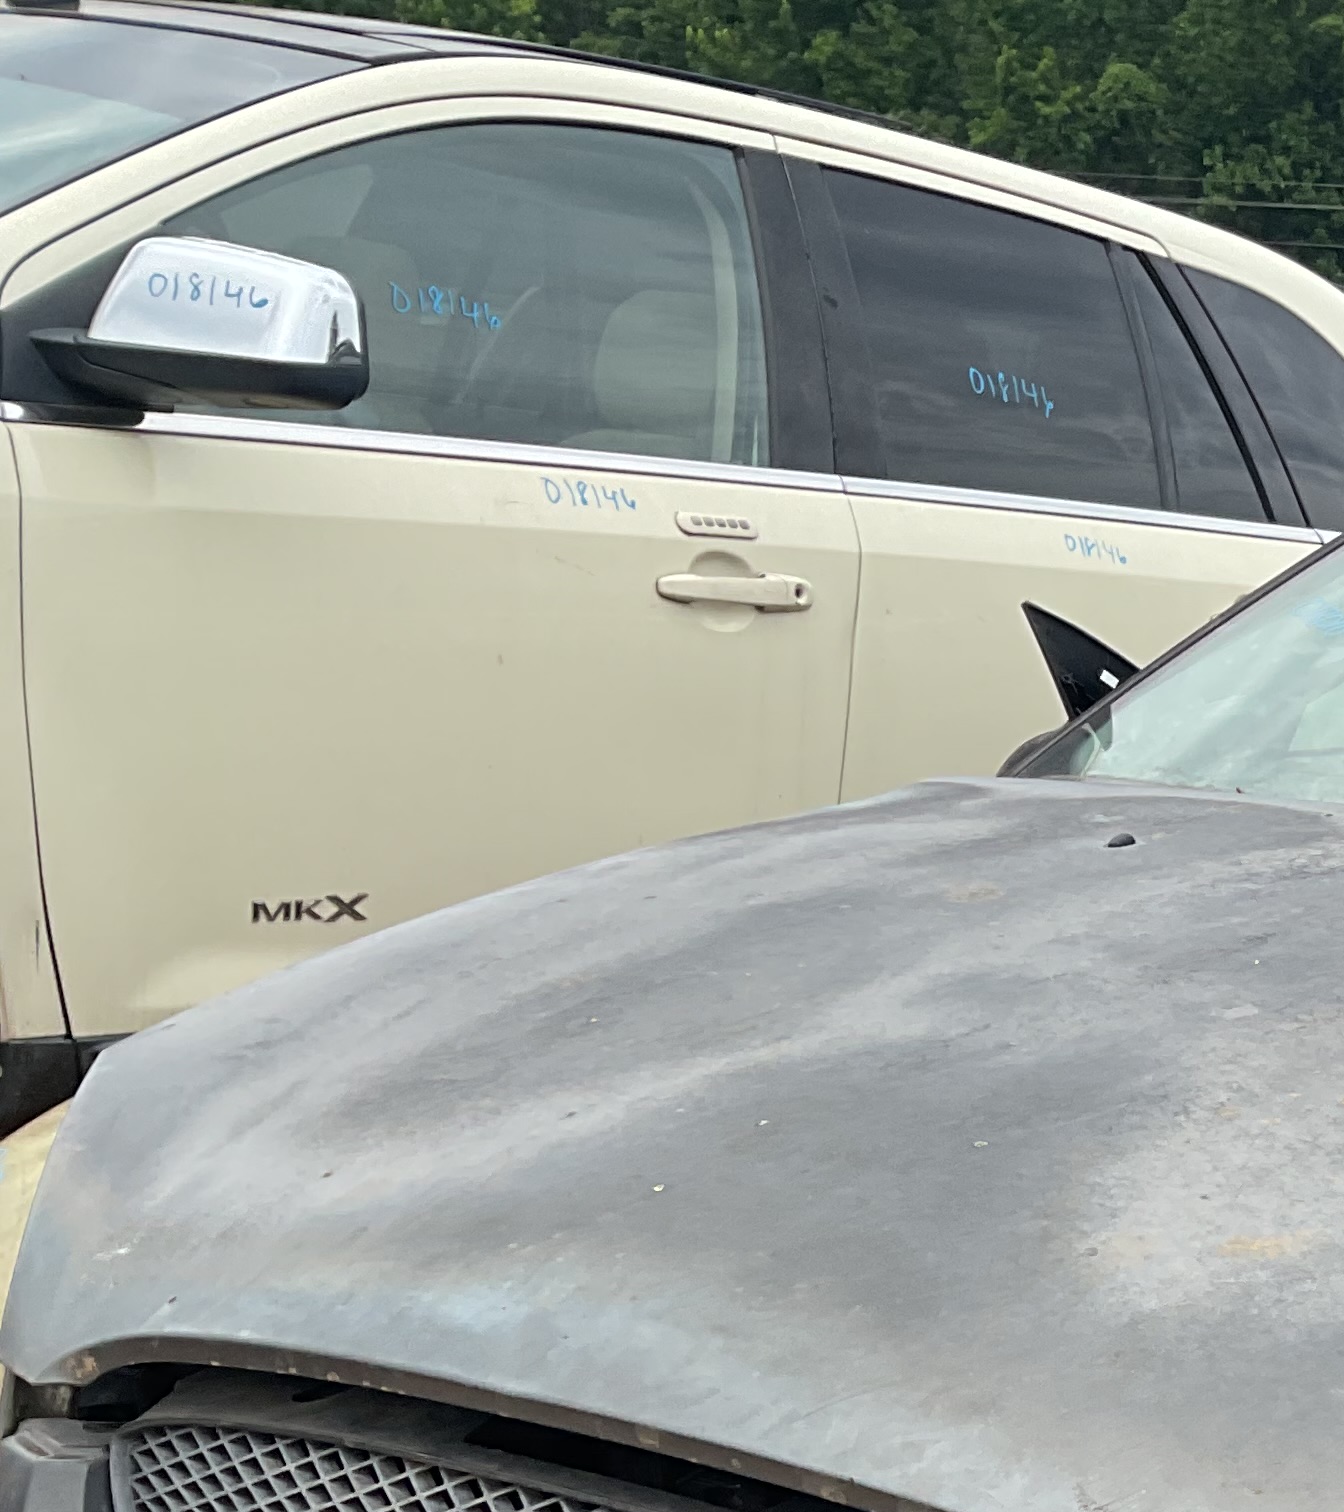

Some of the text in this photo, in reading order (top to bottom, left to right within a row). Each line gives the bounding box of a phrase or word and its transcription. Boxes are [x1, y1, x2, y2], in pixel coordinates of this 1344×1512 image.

[149, 273, 269, 308] 018146
[389, 281, 501, 330] 018146
[540, 476, 636, 512] 018146
[251, 893, 369, 923] MKX
